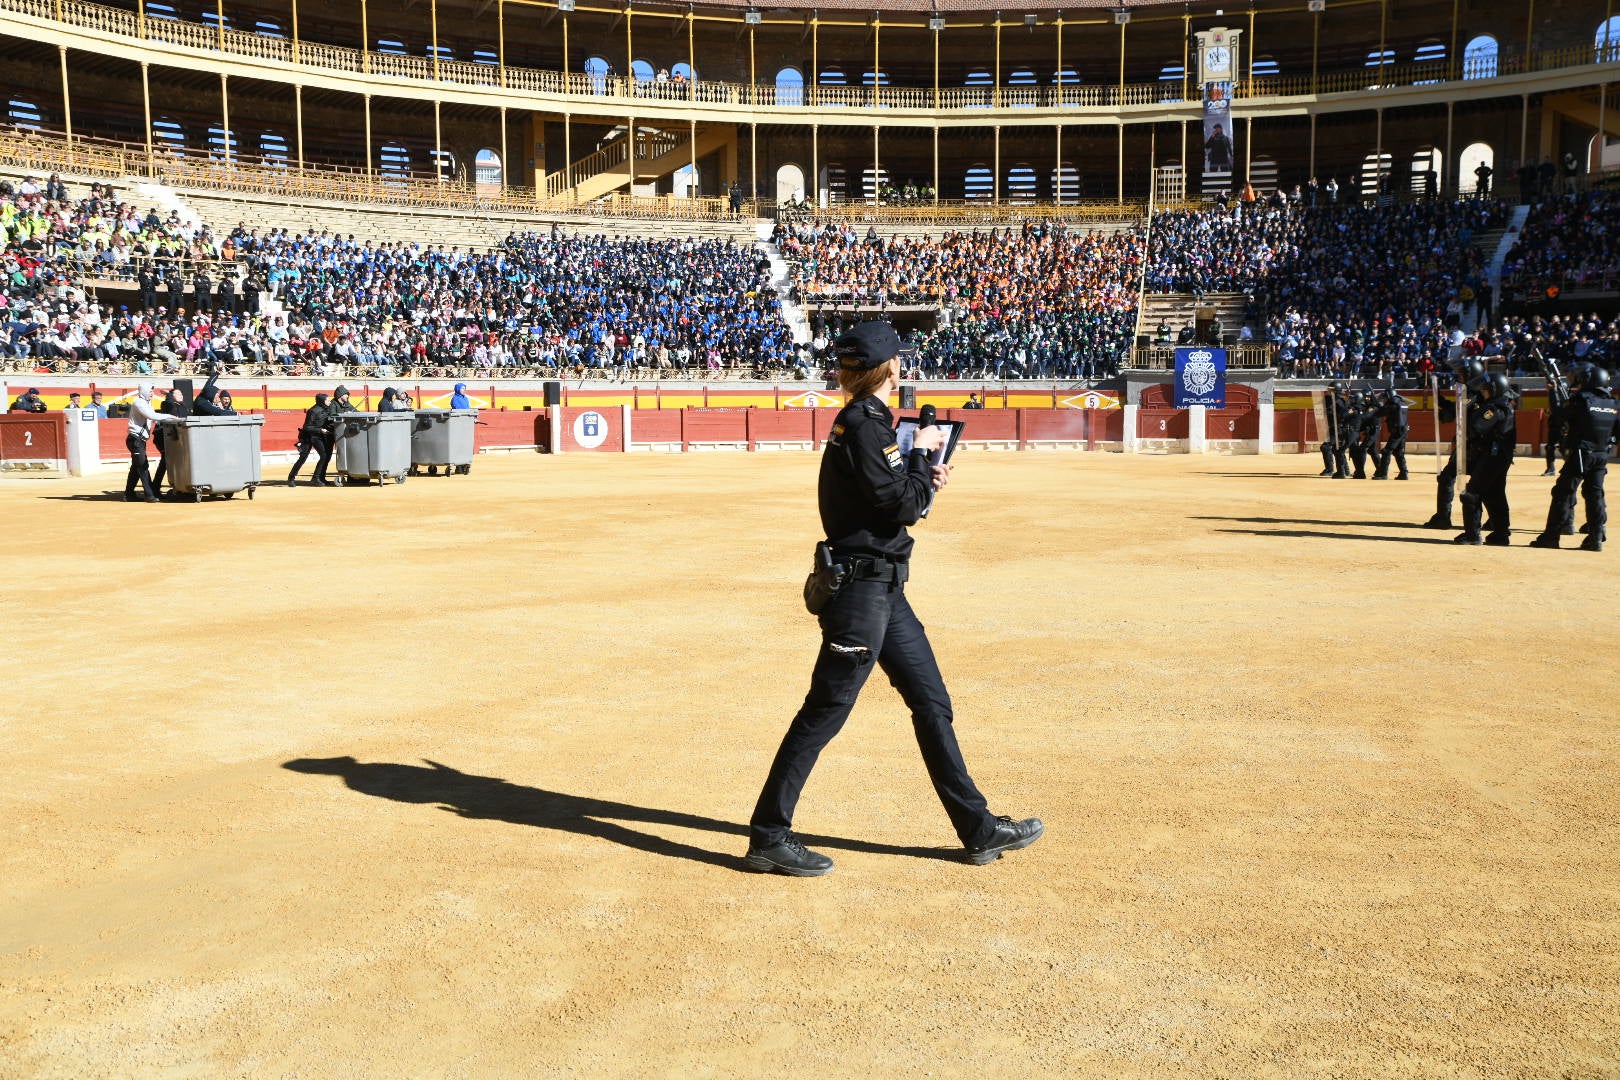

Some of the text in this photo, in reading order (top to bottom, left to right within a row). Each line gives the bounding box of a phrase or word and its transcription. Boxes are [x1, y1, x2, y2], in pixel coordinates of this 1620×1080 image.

[808, 398, 814, 406] 5
[1090, 398, 1094, 407] 5
[1160, 420, 1166, 431] 3
[1228, 420, 1235, 431] 3
[24, 432, 32, 446] 2
